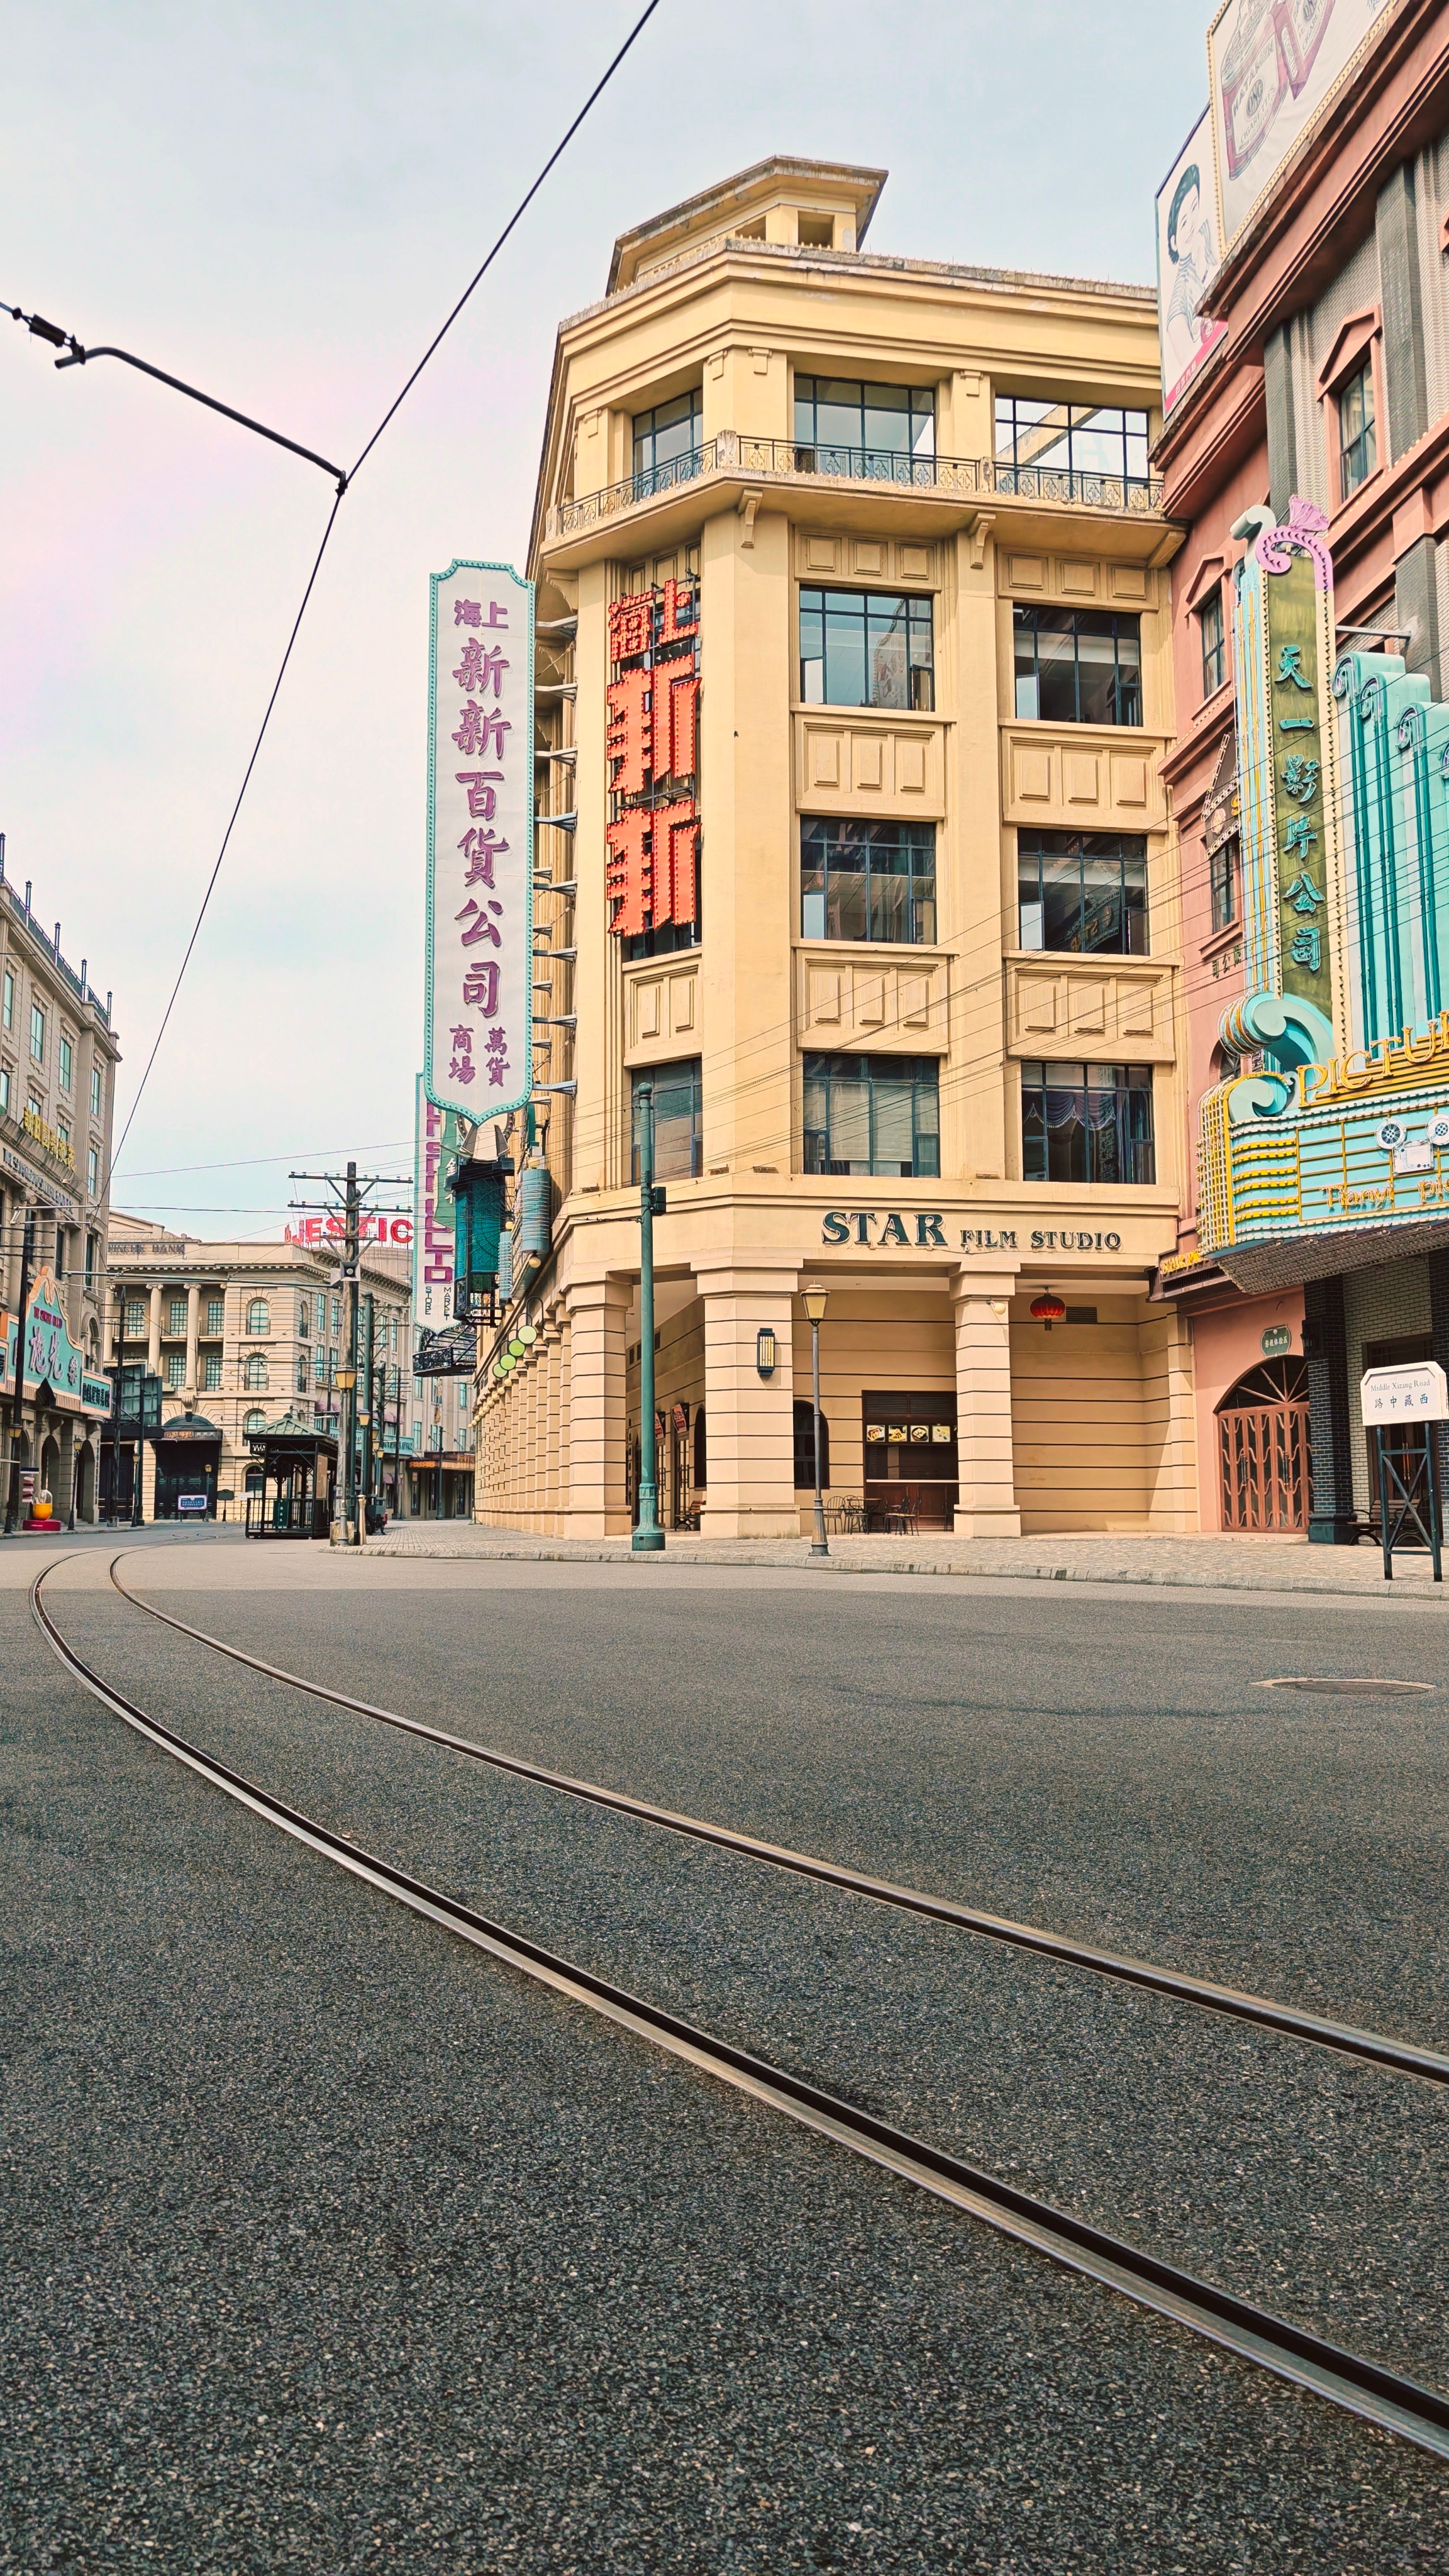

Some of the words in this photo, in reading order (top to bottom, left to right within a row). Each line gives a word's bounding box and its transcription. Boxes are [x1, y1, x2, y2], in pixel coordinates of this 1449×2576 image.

[452, 637, 511, 1018] 新新百貨公司
[1275, 645, 1325, 971] 天一影片公司
[449, 1024, 475, 1084] 商場
[485, 1027, 510, 1087] 萬貨
[1319, 1180, 1394, 1211] Tianyi
[822, 1212, 948, 1245] STAR
[960, 1230, 1018, 1248] FILM
[1030, 1230, 1122, 1250] STUDIO
[1370, 1384, 1391, 1392] Middle
[1392, 1381, 1413, 1390] Xizang
[1414, 1378, 1431, 1387] Road
